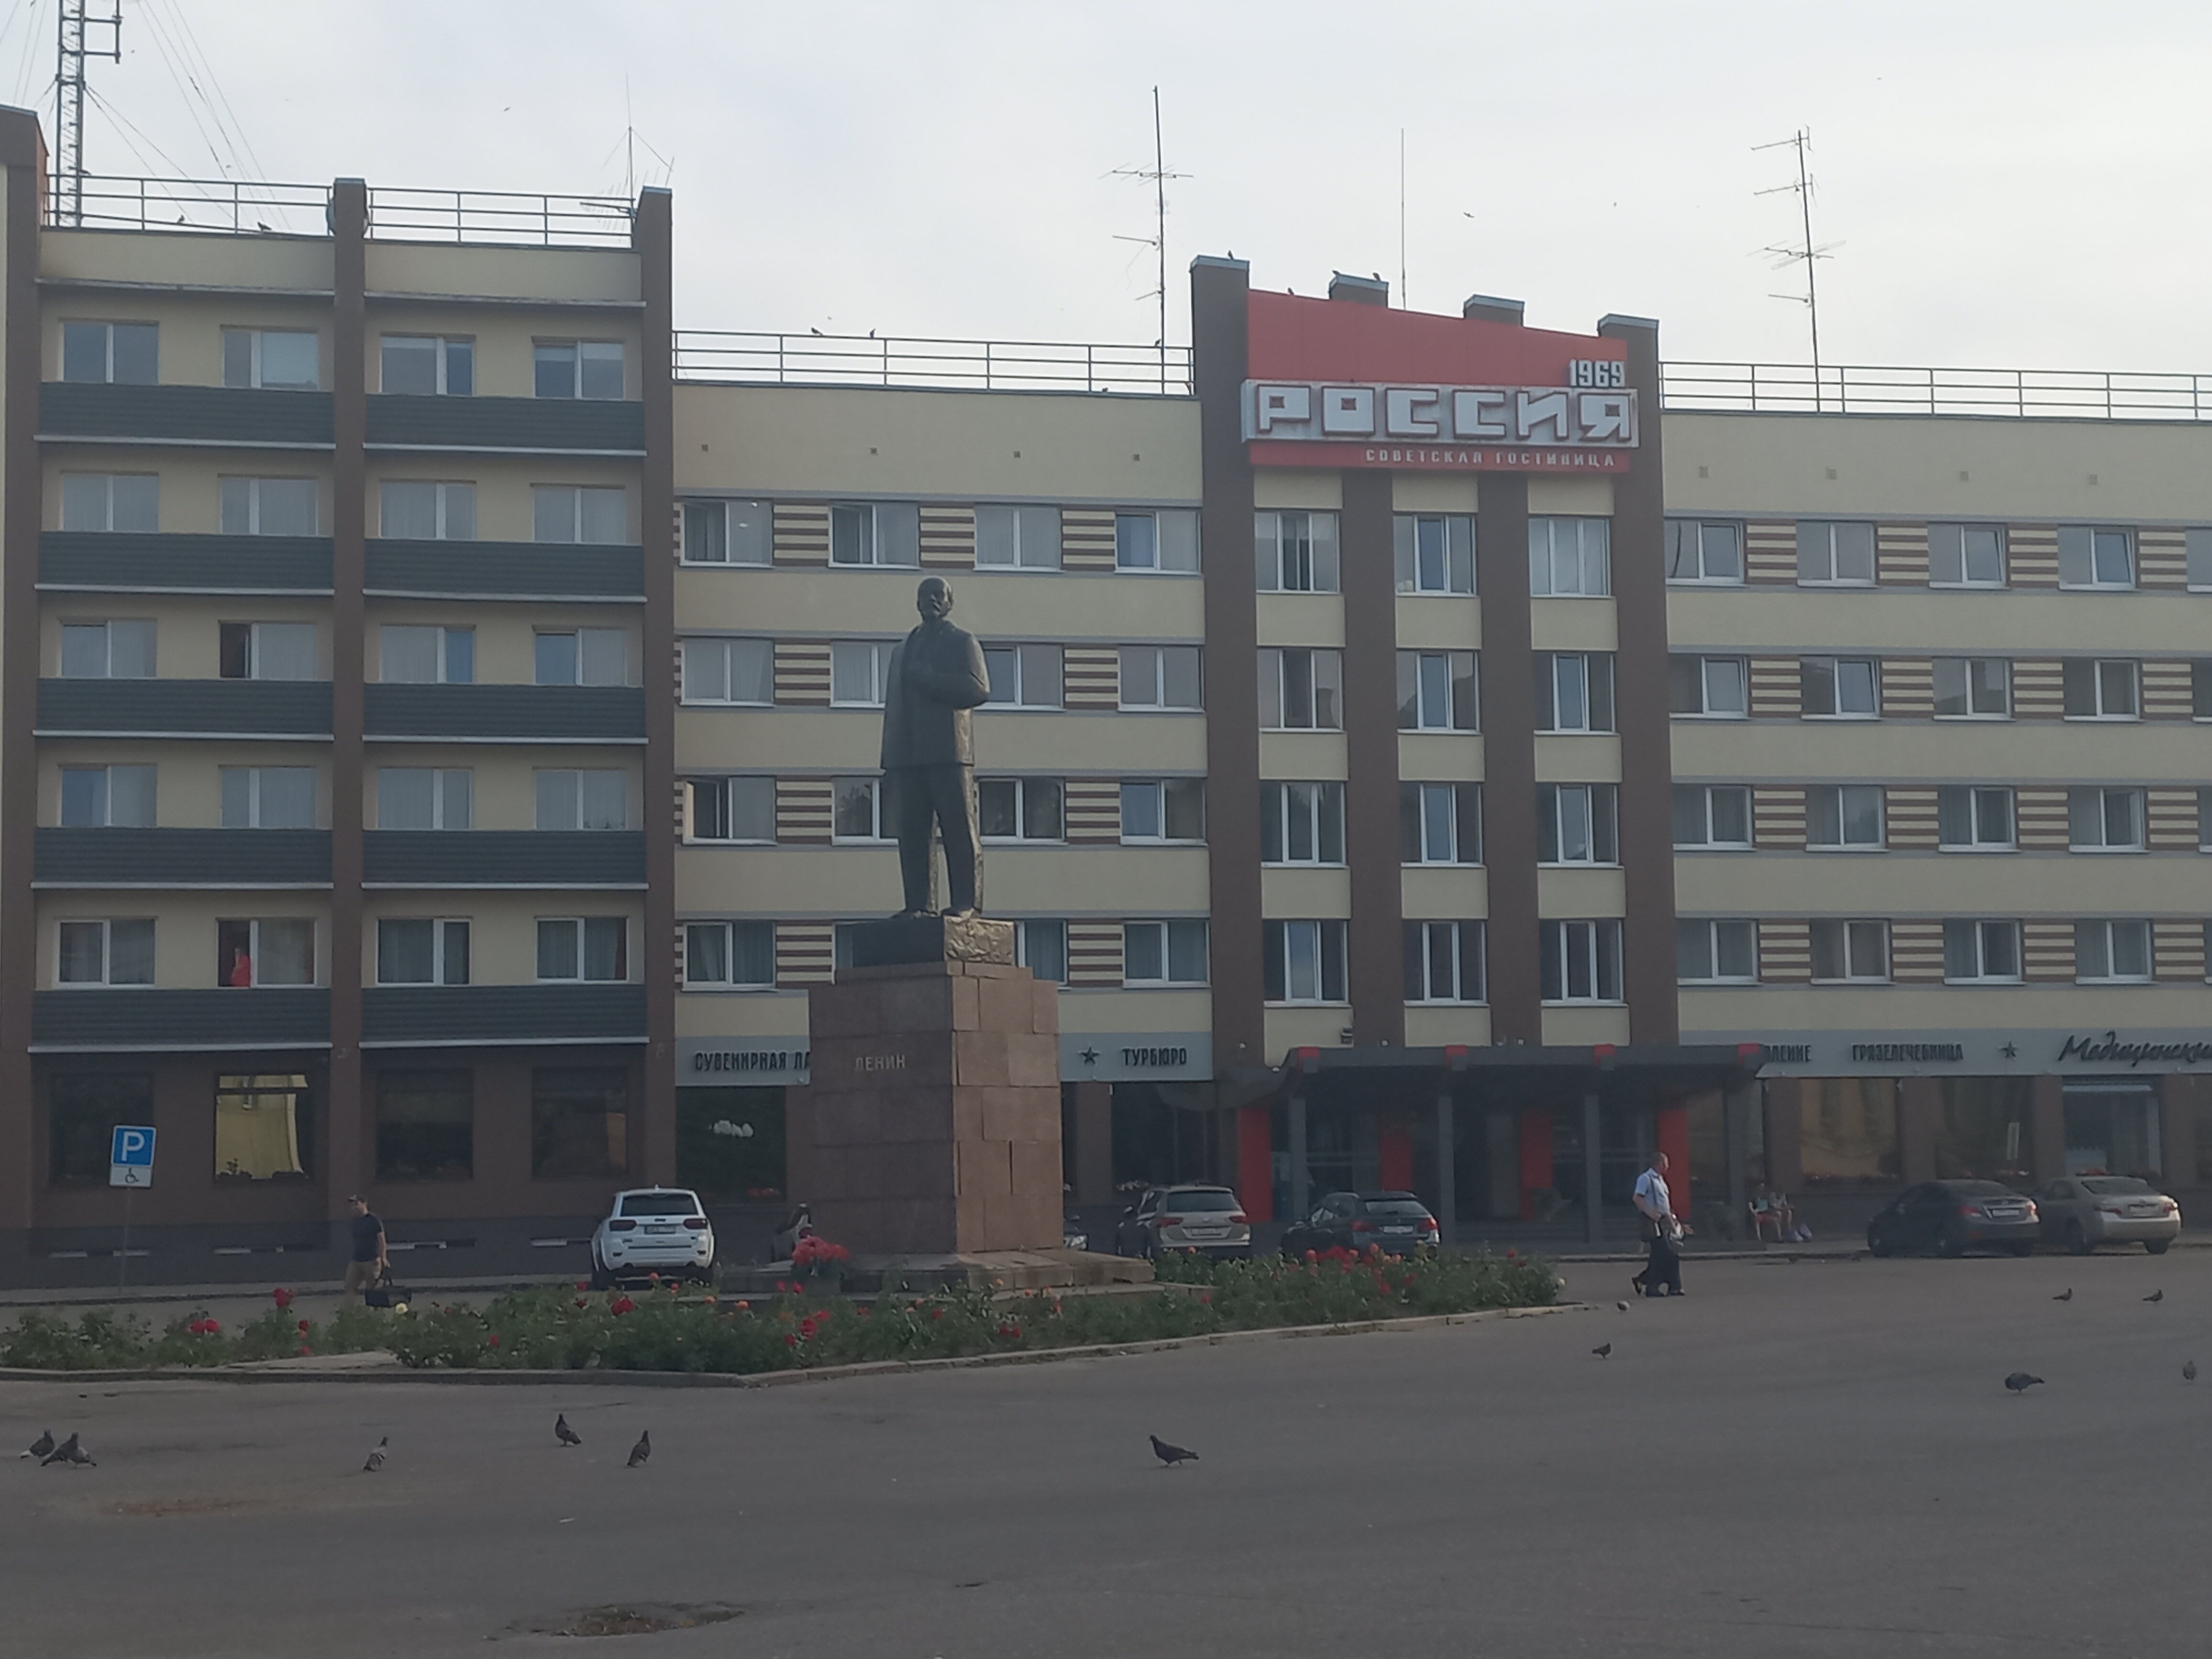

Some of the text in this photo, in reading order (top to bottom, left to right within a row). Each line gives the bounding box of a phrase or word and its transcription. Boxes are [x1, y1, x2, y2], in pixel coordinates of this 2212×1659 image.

[1570, 359, 1625, 387] 1969
[1257, 385, 1632, 440] РОССИЯ
[1366, 449, 1614, 467] СОВЕТСКАЯ ГОСТИНИЦА
[695, 1052, 787, 1071] СУВЕНИРНАЯ
[855, 1054, 905, 1072] ЛЕНИН
[1122, 1048, 1187, 1066] ТУРБЮРО
[121, 1131, 144, 1161] P
